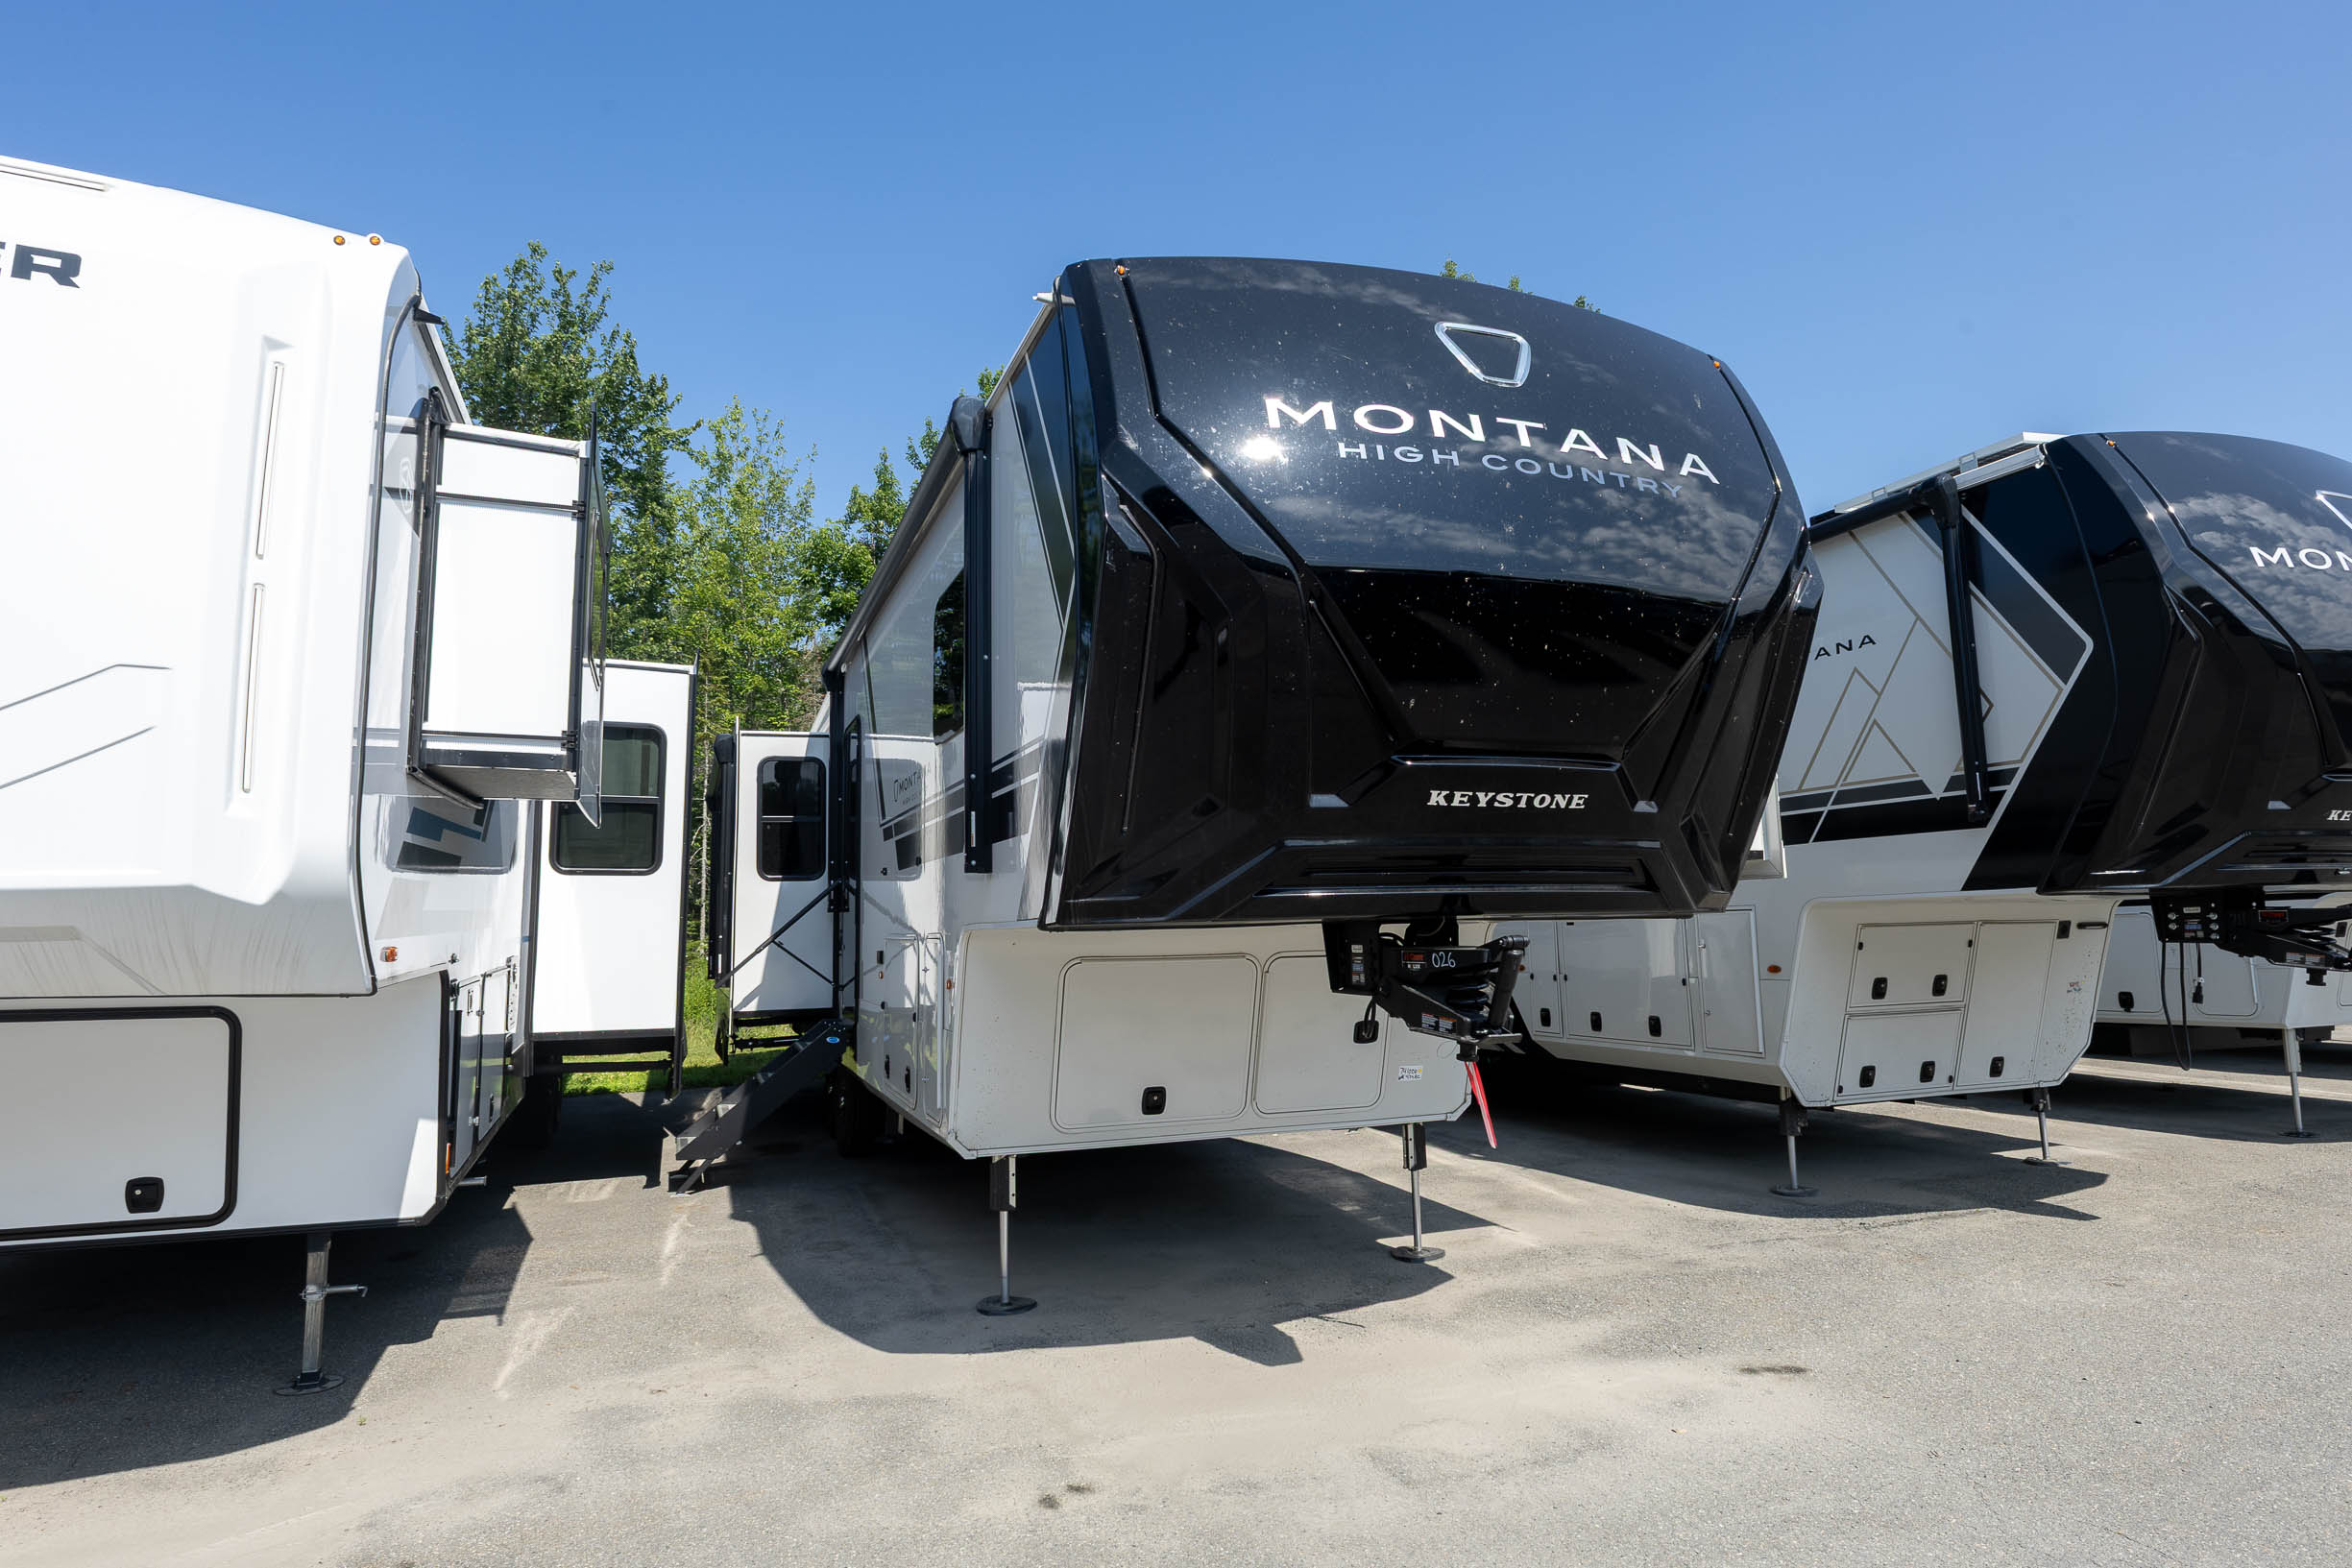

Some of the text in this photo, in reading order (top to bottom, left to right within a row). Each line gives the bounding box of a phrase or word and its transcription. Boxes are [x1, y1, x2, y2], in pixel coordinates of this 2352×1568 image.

[1265, 398, 1720, 484] MONTANA
[1338, 442, 1683, 498] HIGH COUNTRY
[1426, 789, 1588, 809] KEYSTONE
[1431, 951, 1456, 968] 026
